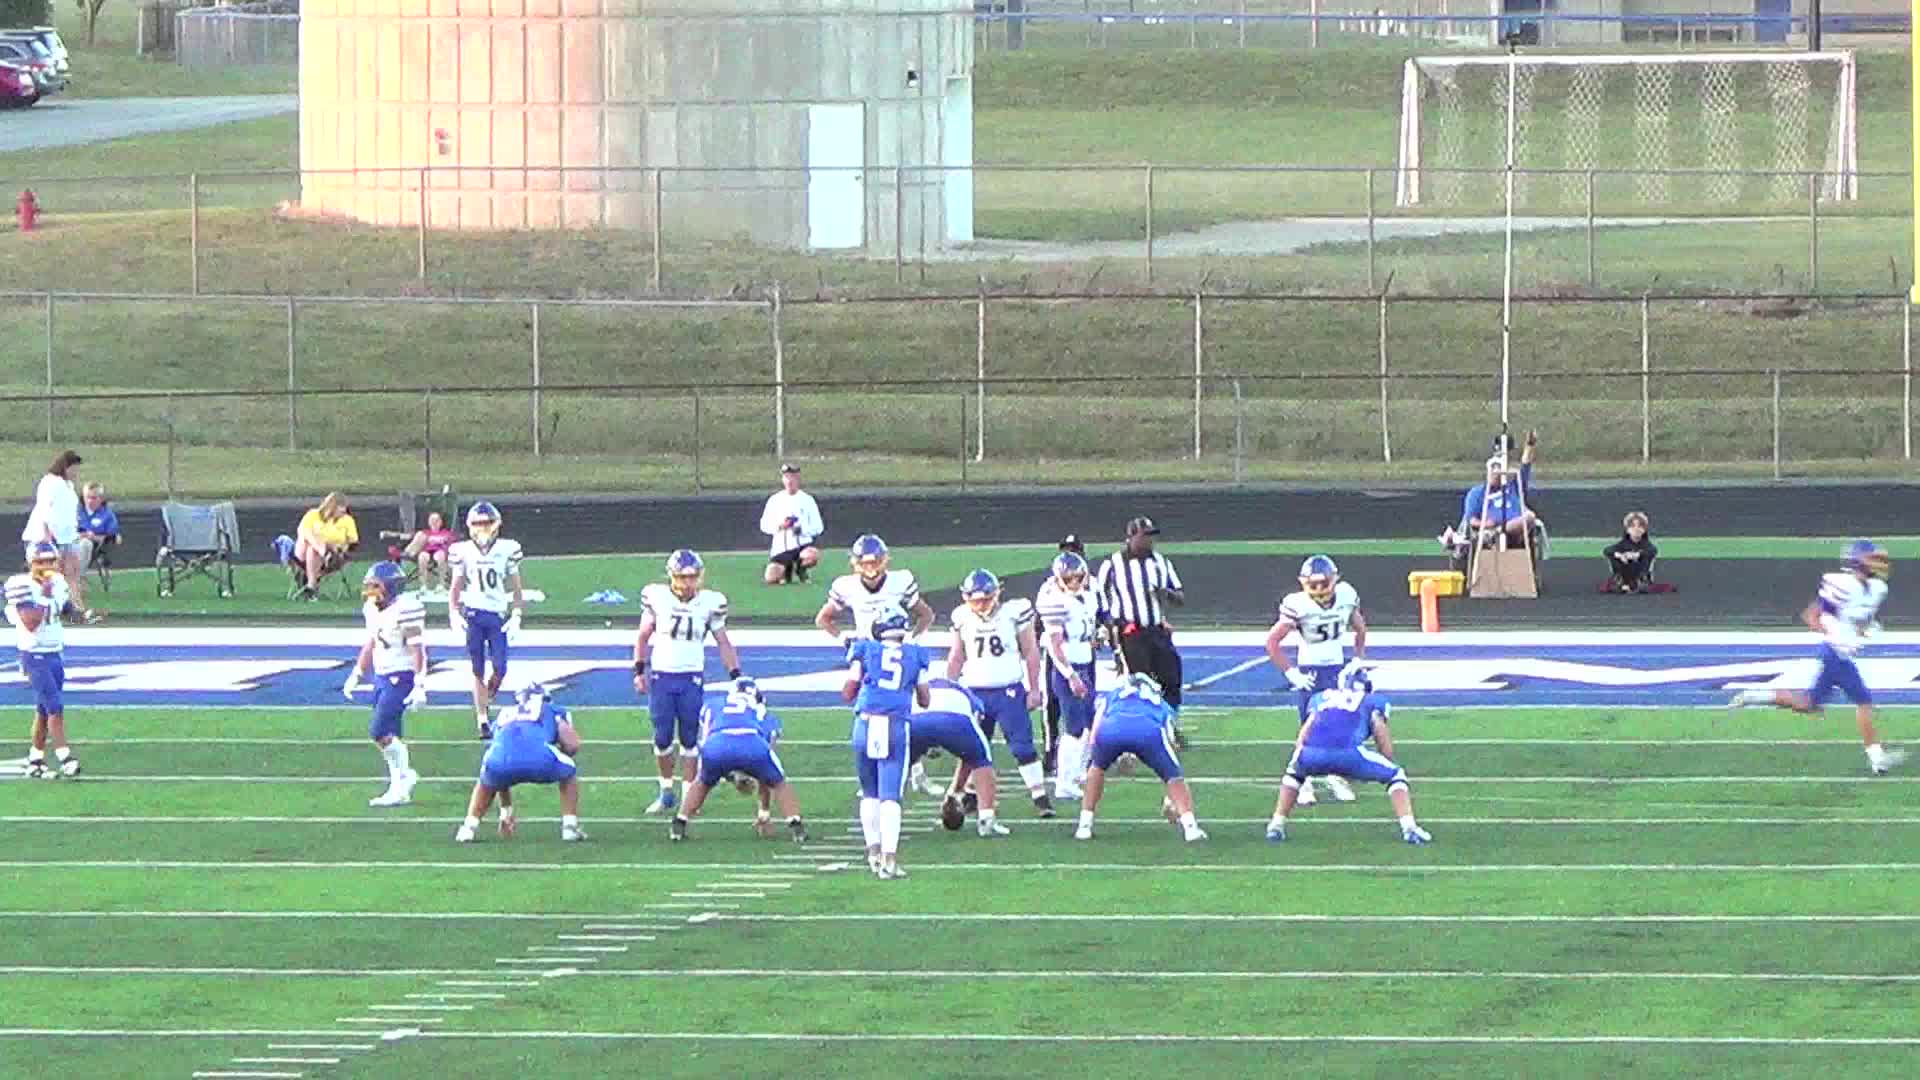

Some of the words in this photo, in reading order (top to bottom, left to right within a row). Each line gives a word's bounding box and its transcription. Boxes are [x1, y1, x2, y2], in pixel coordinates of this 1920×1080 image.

[478, 567, 498, 592] 10
[671, 615, 693, 641] 71
[1317, 622, 1342, 642] 51
[973, 635, 1005, 658] 78
[878, 643, 903, 690] 5
